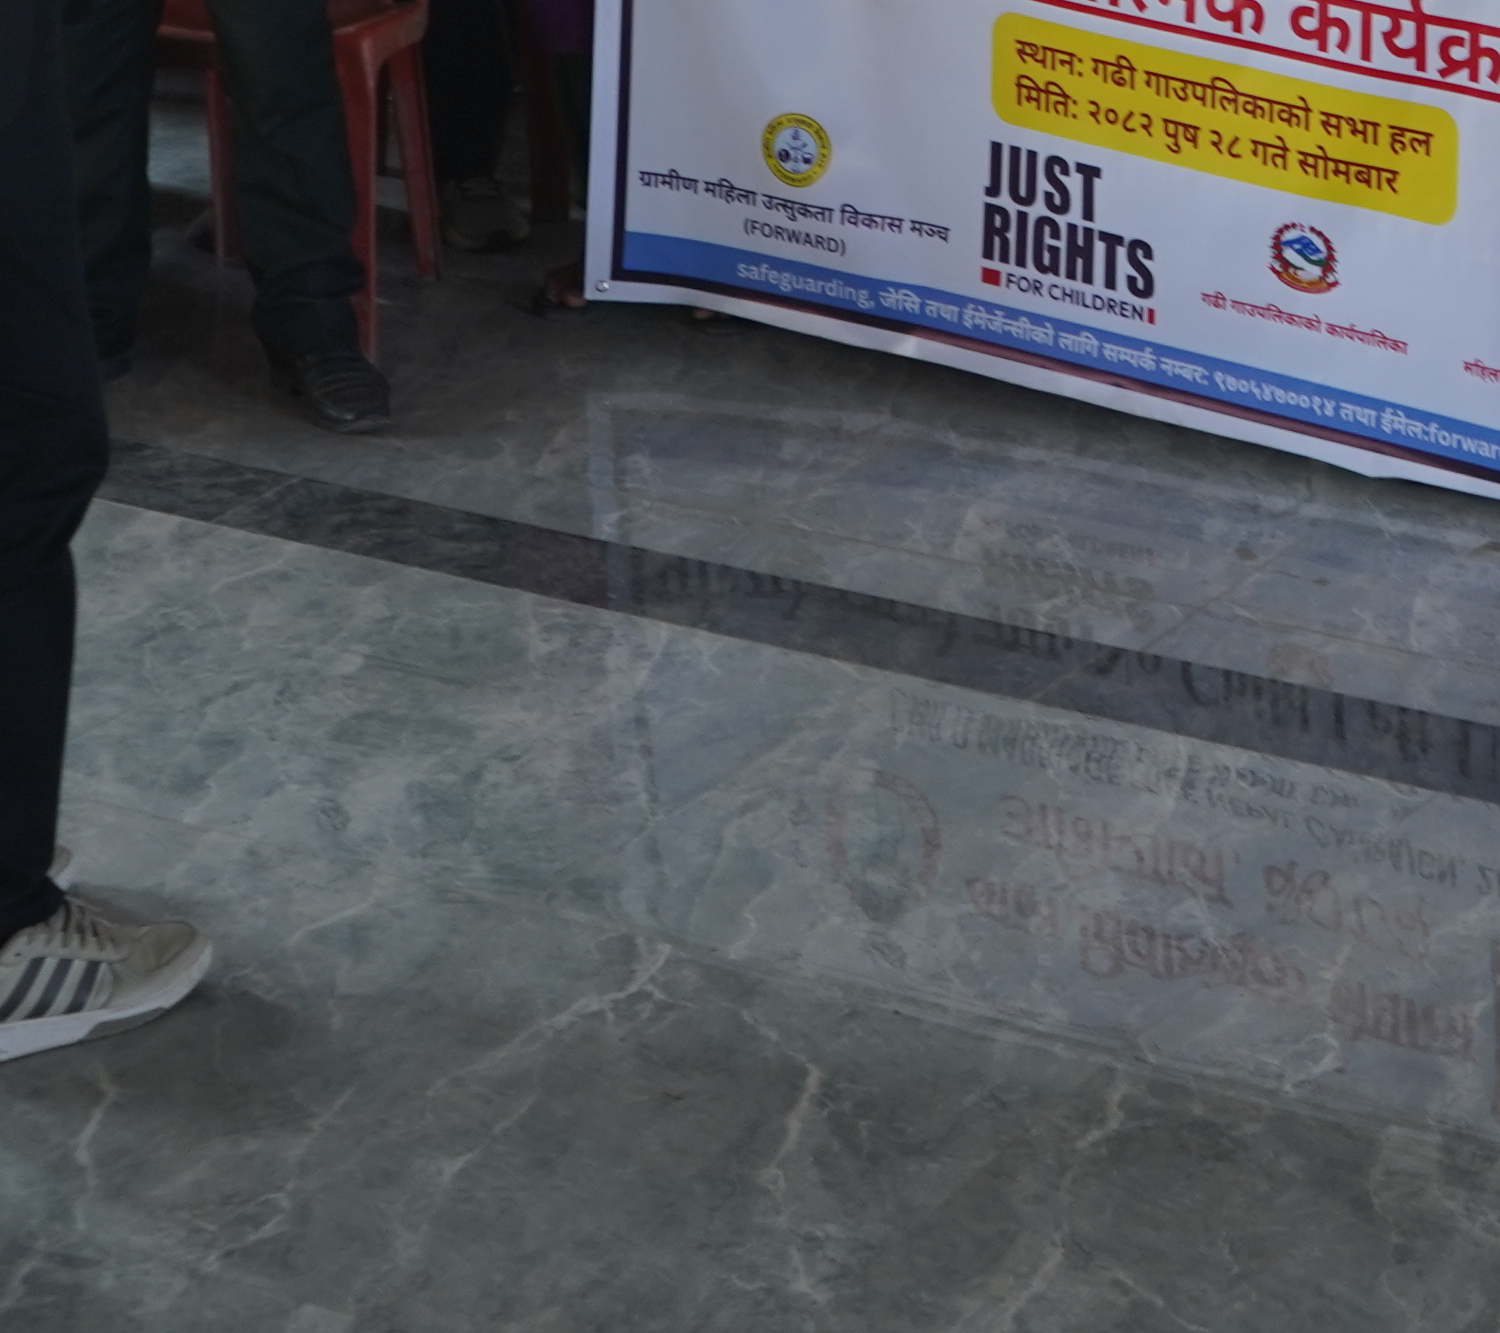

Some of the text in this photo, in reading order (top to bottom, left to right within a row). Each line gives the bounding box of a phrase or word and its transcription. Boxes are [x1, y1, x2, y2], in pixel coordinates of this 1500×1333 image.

[1014, 39, 1084, 78] स्थान:
[1091, 56, 1136, 90] गढी
[1320, 109, 1380, 145] सभा
[1387, 125, 1432, 157] हल
[1014, 76, 1398, 193] मिति: २०८२ पुष २८ गते सोमबार
[703, 178, 758, 206] महिला
[839, 204, 904, 233] विकास
[983, 140, 1102, 224] JUST
[743, 219, 846, 256] (FORWARD)
[982, 202, 1156, 300] RIGHTS
[736, 261, 876, 310] safeguarding,
[1006, 273, 1145, 323] FOR CHILDREN
